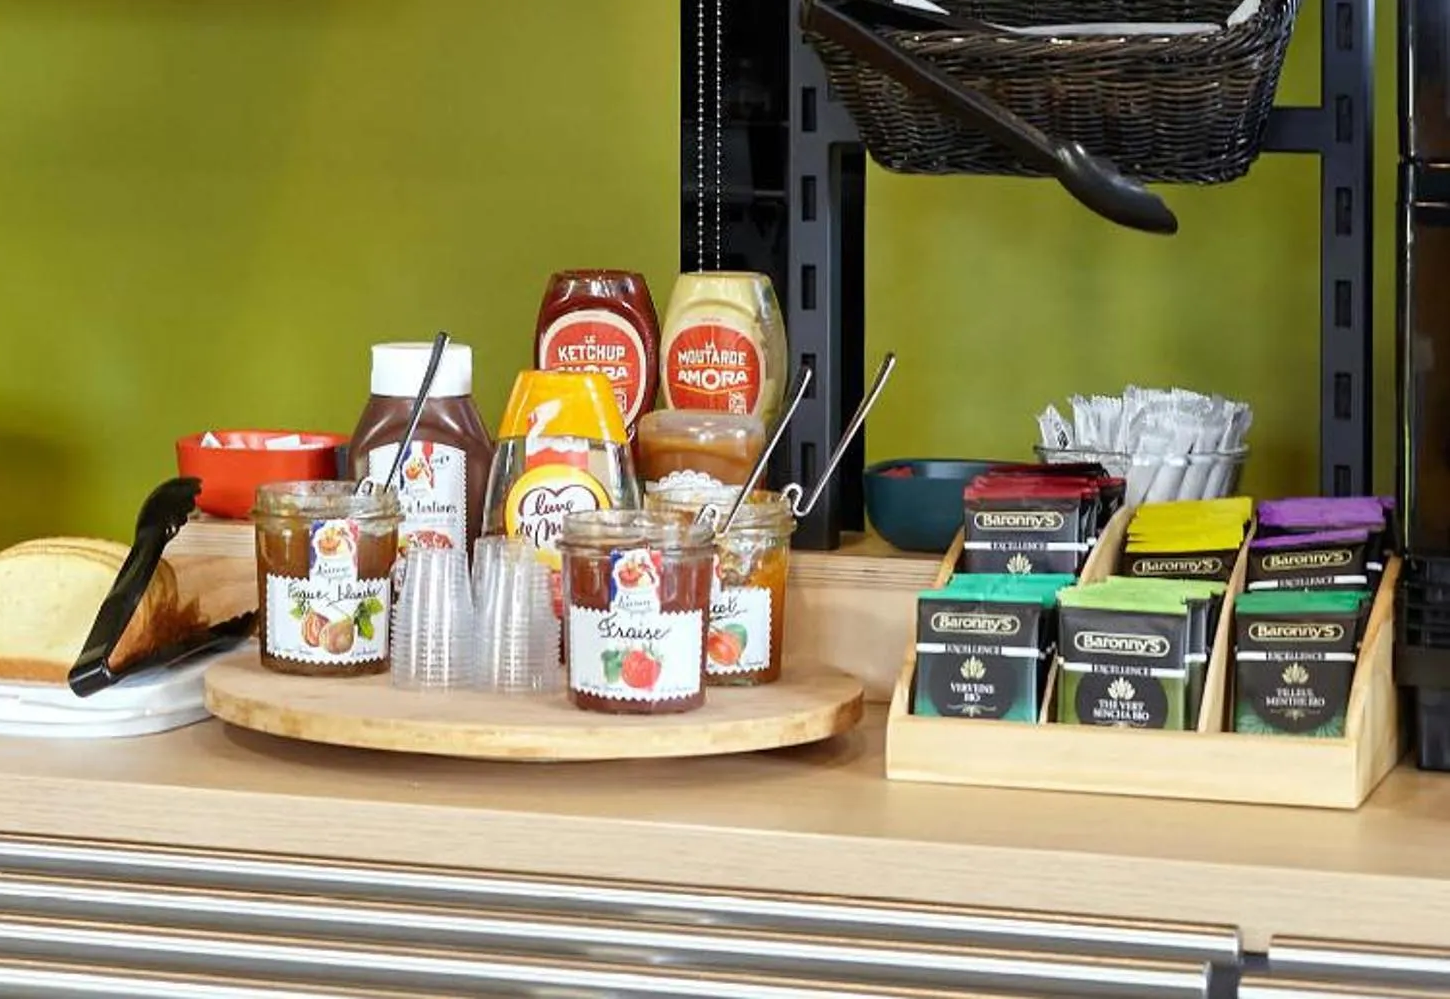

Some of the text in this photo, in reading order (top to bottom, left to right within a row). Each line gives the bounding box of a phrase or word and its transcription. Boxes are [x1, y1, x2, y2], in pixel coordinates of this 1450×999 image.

[583, 334, 597, 344] LE
[705, 341, 716, 351] LA
[557, 344, 626, 362] KETCHUP
[677, 350, 747, 367] MOUTARDE
[677, 366, 749, 390] AMORA
[597, 612, 672, 640] Fraise
